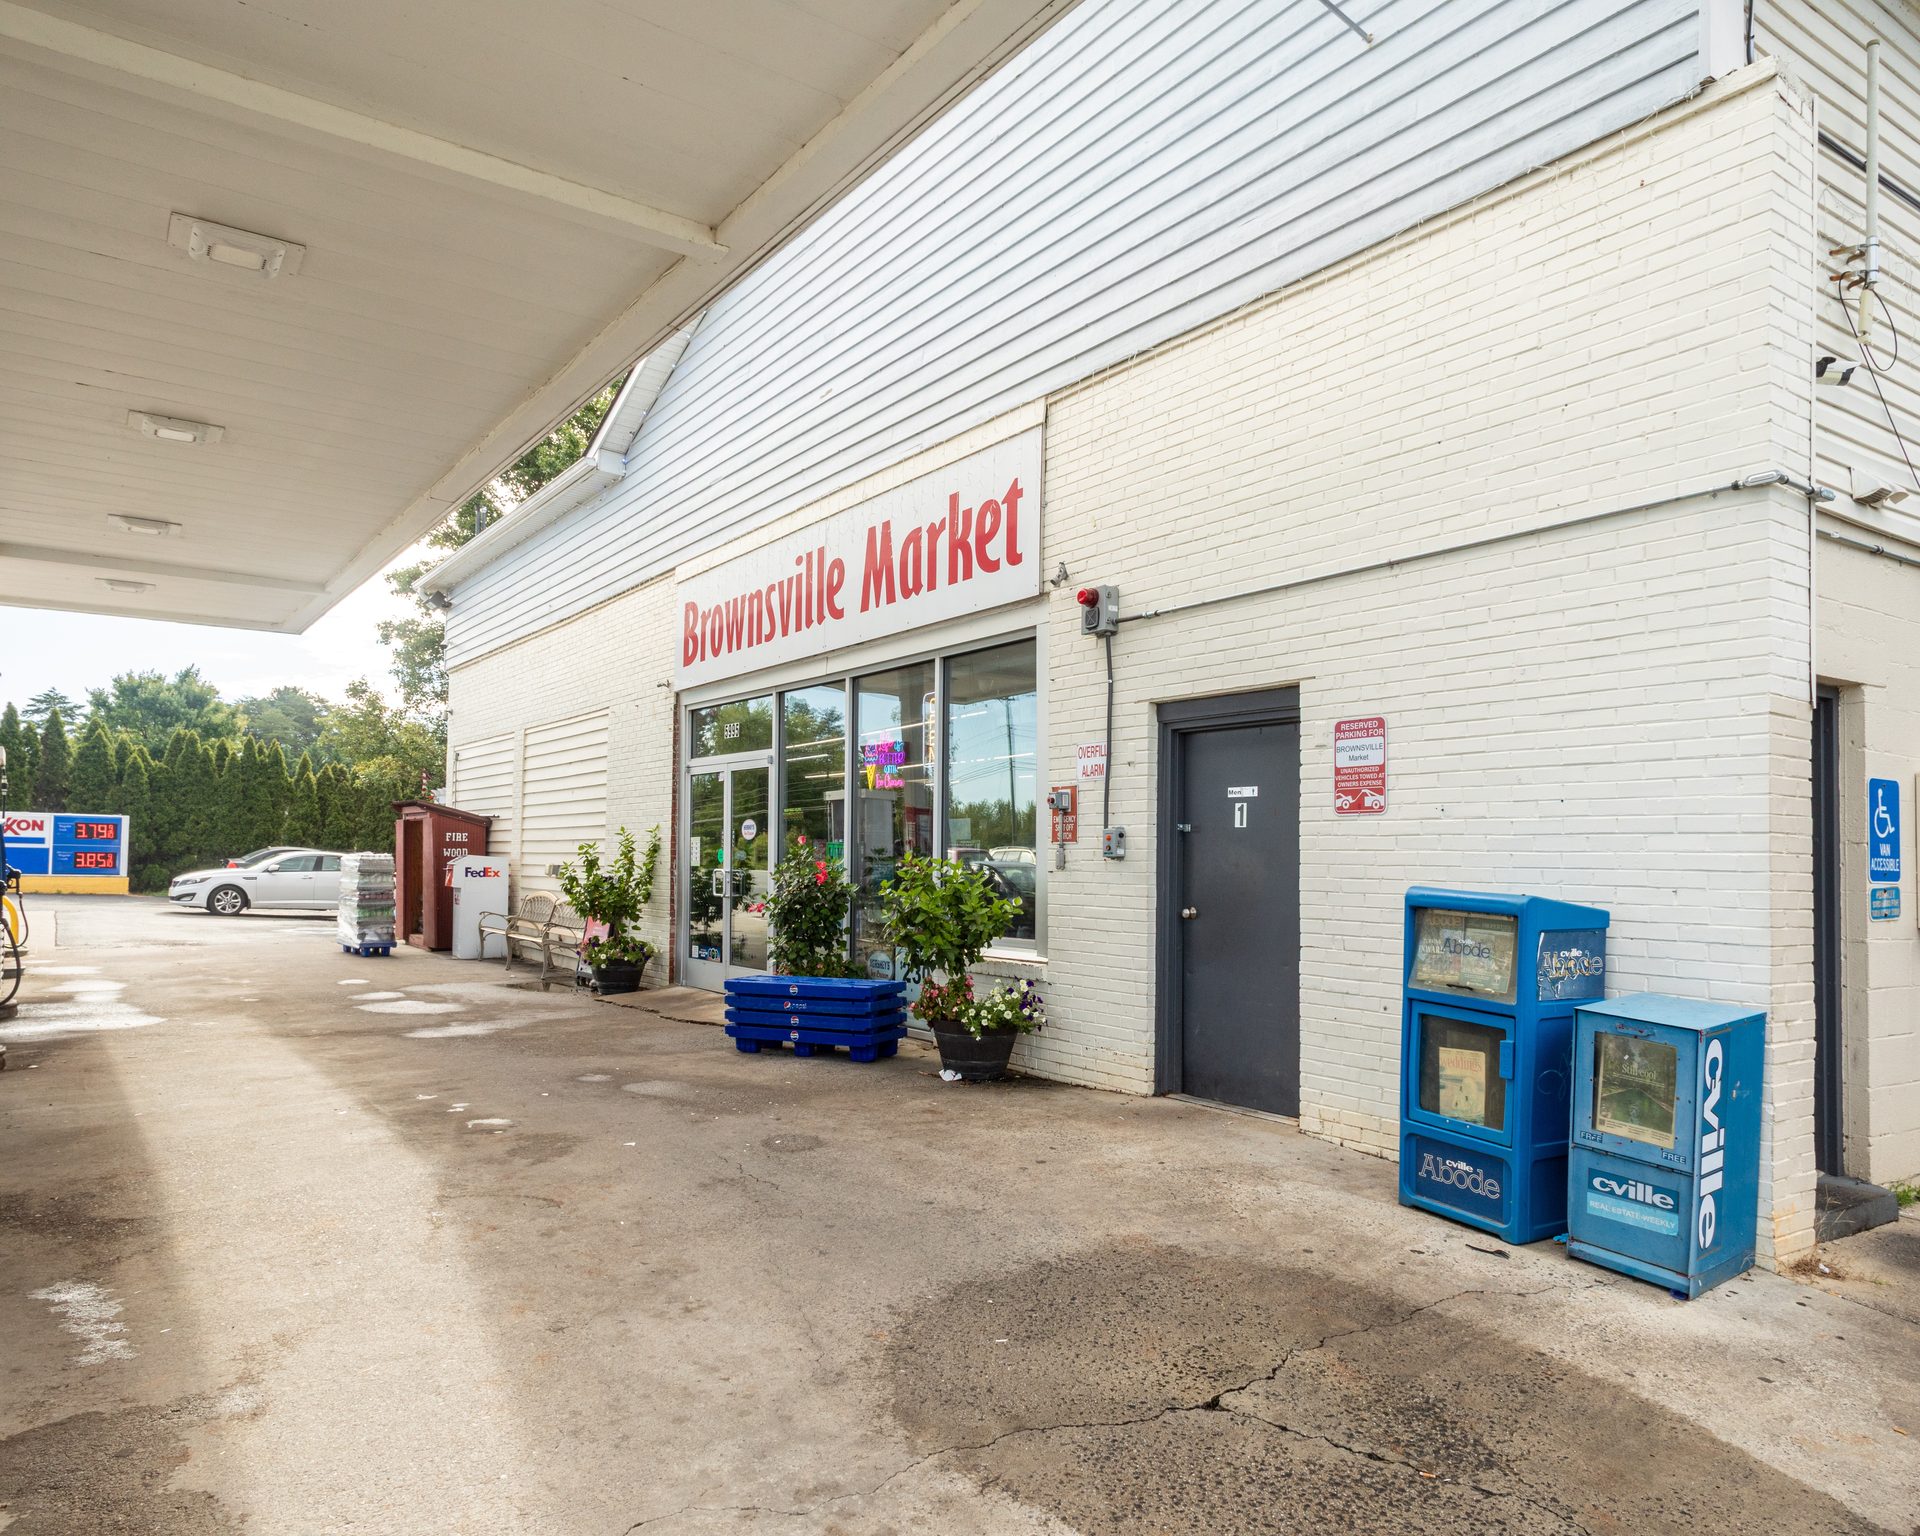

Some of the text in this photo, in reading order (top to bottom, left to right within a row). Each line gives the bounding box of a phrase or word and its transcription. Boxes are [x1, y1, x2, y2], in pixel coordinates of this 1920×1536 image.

[682, 477, 1024, 668] Brownsville Market
[724, 723, 739, 738] 5995
[1340, 721, 1378, 730] RESERVED
[1336, 728, 1384, 740] PARKING FOR
[1078, 744, 1107, 759] OVERFILL
[1336, 743, 1383, 753] BROWNSVILLE
[1082, 764, 1104, 777] ALARM
[1340, 766, 1380, 774] UNAUTHORIZED
[1237, 804, 1244, 826] 1
[446, 832, 468, 842] FIRE
[443, 848, 468, 857] WOOD
[1880, 844, 1890, 856] VAN
[1871, 858, 1899, 871] ACCESSIBLE
[465, 867, 500, 878] FedEx
[1442, 938, 1490, 959] Abode
[1440, 1055, 1482, 1072] weddings
[1622, 1064, 1638, 1076] Still
[1639, 1070, 1657, 1080] cool
[1699, 1038, 1725, 1249] cville
[1662, 1152, 1686, 1163] FREE
[1446, 1159, 1473, 1173] cville
[1419, 1153, 1500, 1199] Abode
[1593, 1177, 1674, 1209] cville
